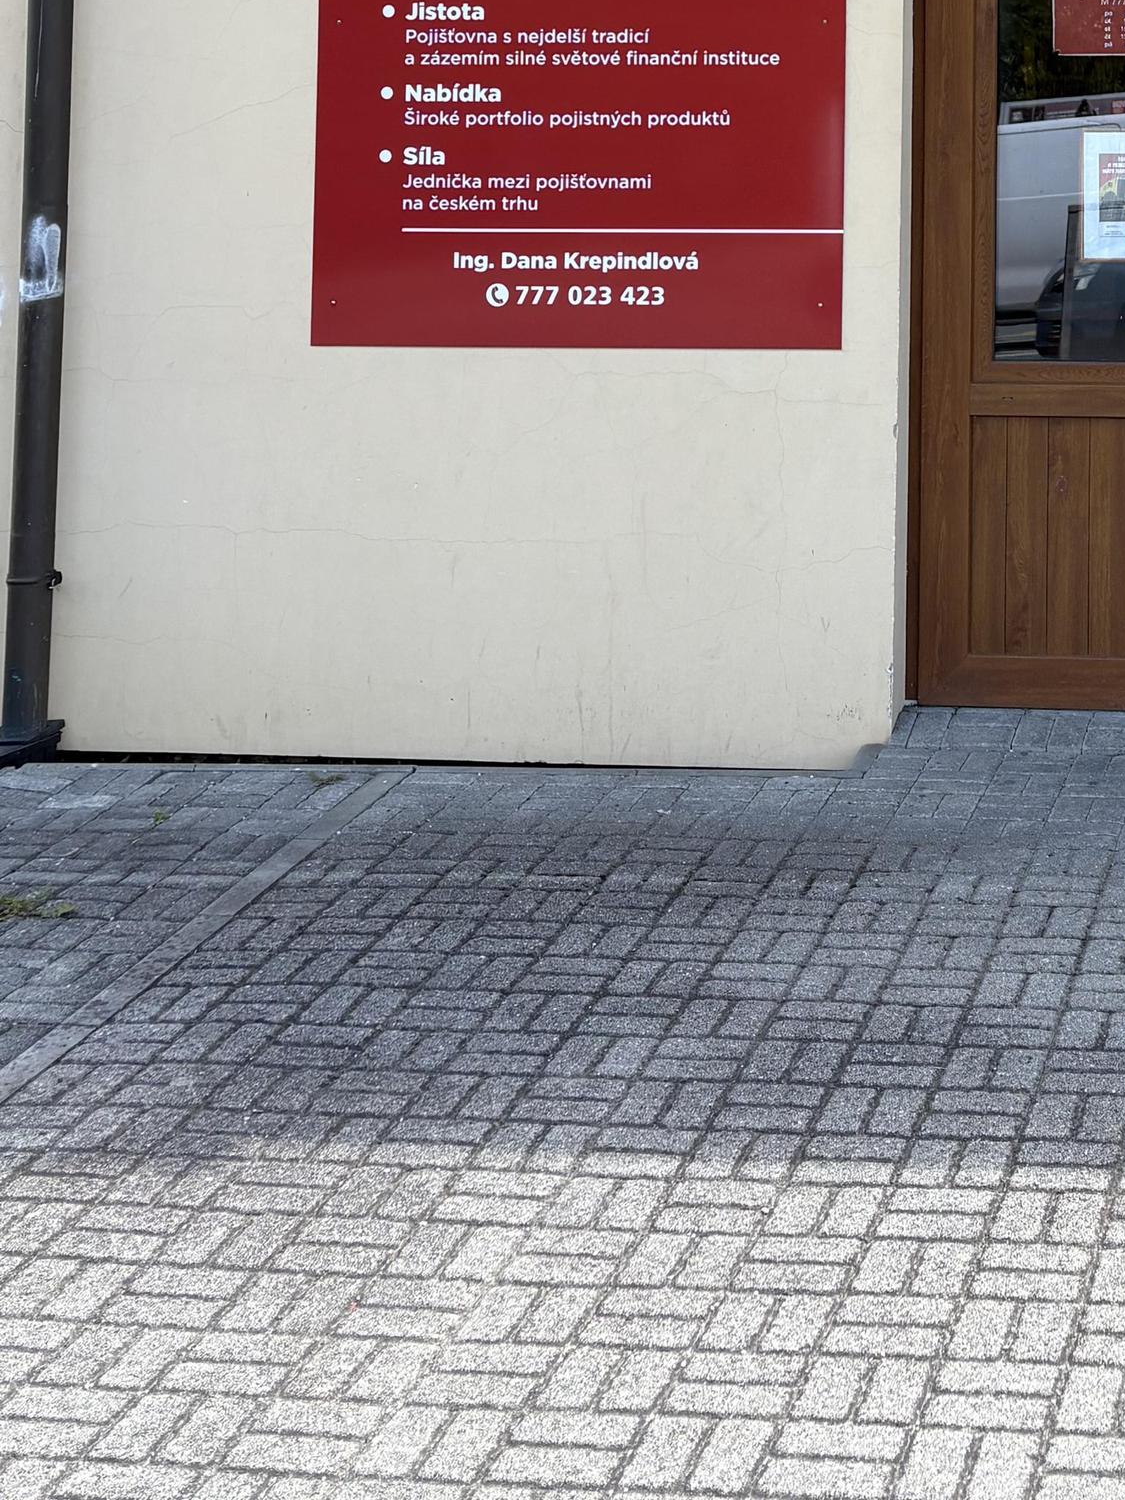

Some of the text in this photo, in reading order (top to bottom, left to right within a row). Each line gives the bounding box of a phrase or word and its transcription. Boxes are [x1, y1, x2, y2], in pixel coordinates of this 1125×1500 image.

[405, 2, 484, 20] Jistota
[406, 28, 649, 46] Pojišťovna s nejdelší tradicí
[405, 50, 780, 65] a zázemím silné světové finanční instituce
[405, 83, 501, 102] Nabídka
[405, 108, 730, 128] Široké portfolio pojistných produktů
[403, 146, 445, 165] Síla
[403, 174, 651, 191] Jednička mezi pojišťovnami
[403, 196, 538, 210] na českém trhu
[454, 251, 698, 273] Ing. Dana Krepindlová
[516, 286, 664, 305] 777 023 423
